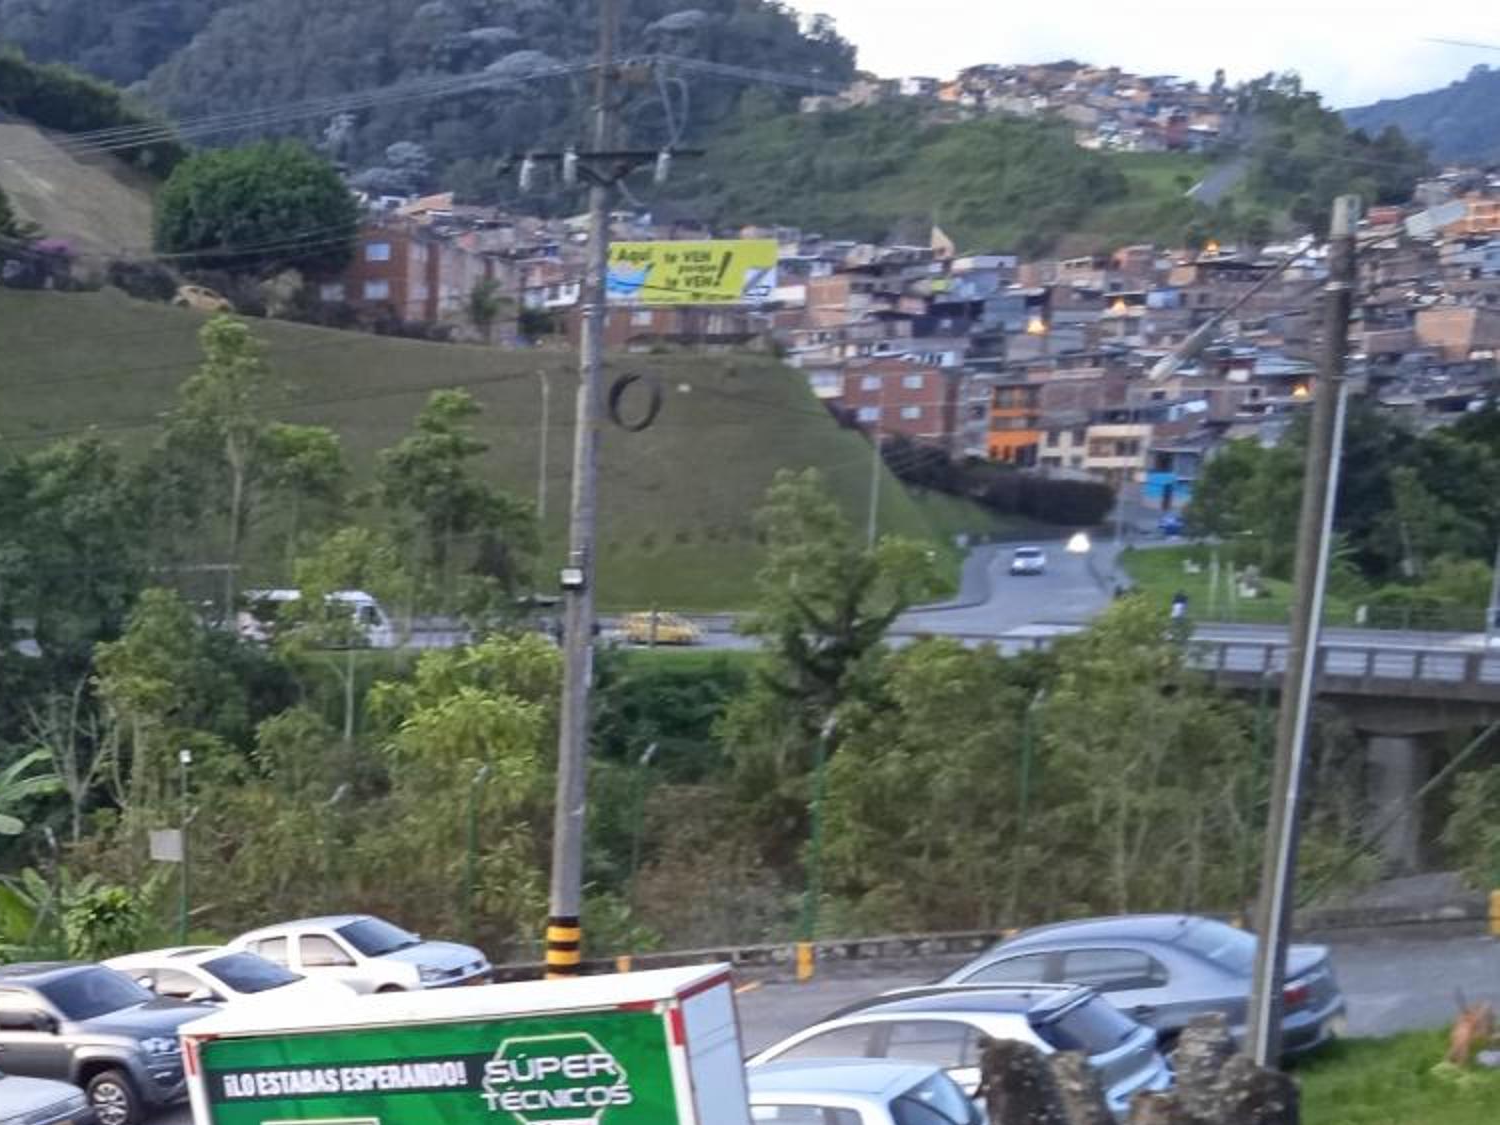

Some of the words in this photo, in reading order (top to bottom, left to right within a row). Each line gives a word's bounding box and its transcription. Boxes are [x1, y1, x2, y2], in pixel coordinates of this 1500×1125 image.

[256, 1069, 340, 1096] ESTABAS
[340, 1061, 468, 1091] ESPERANDO!
[484, 1053, 617, 1083] SÚPER
[480, 1085, 633, 1111] TÉCNICOS
